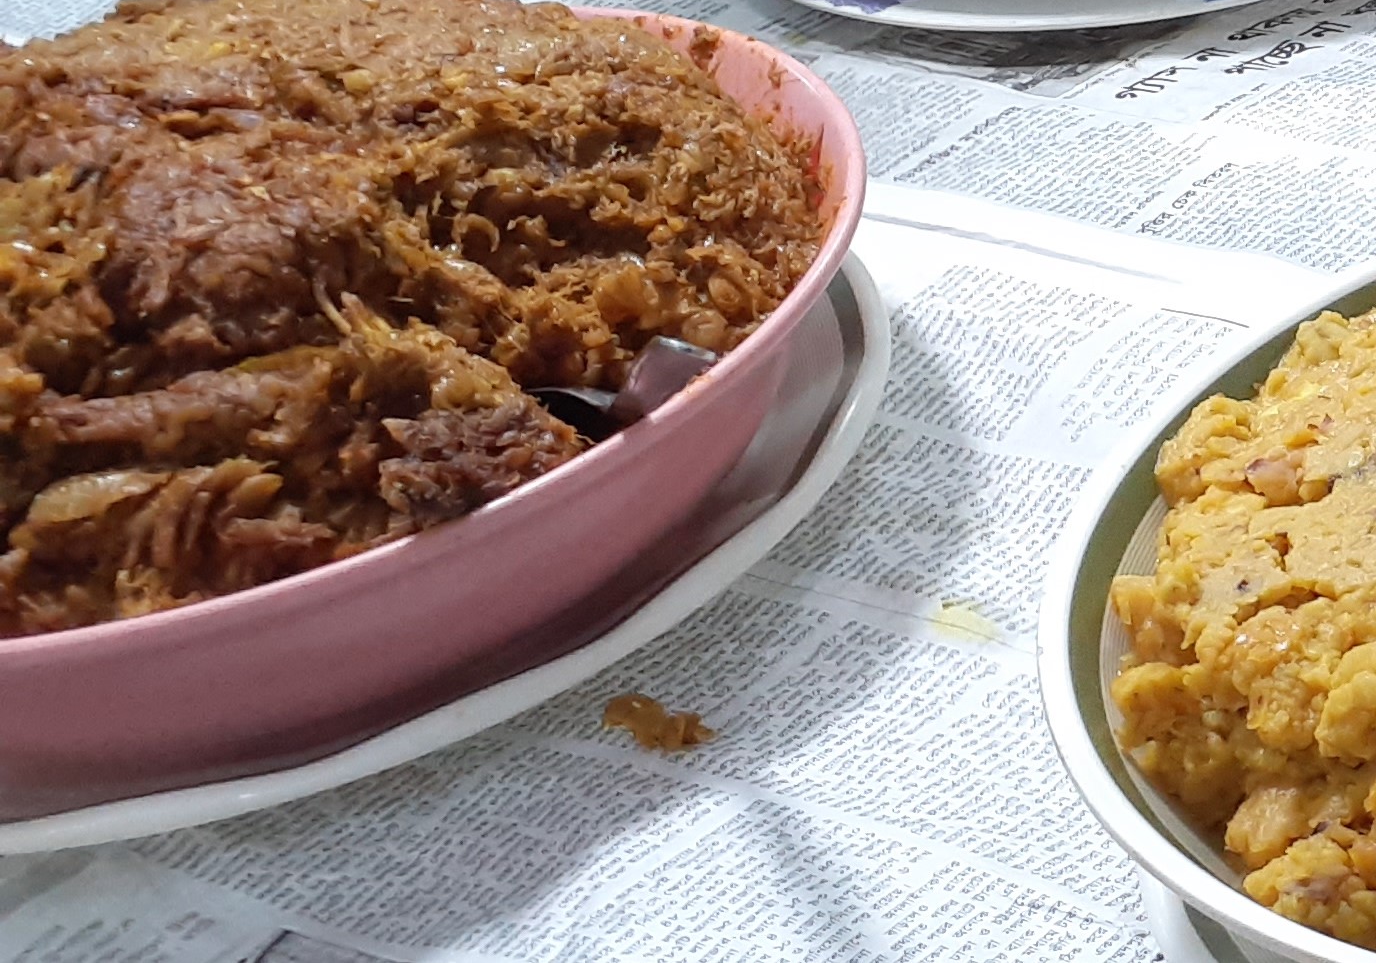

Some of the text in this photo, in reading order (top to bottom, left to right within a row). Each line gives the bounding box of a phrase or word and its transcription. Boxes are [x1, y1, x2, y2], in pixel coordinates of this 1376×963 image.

[1115, 65, 1198, 99] গ্যাস
[1184, 46, 1240, 62] না
[1224, 39, 1325, 75] পাচ্ছে
[1298, 20, 1352, 37] না
[1172, 190, 1199, 209] চেক
[1192, 163, 1240, 187] বিতরণ
